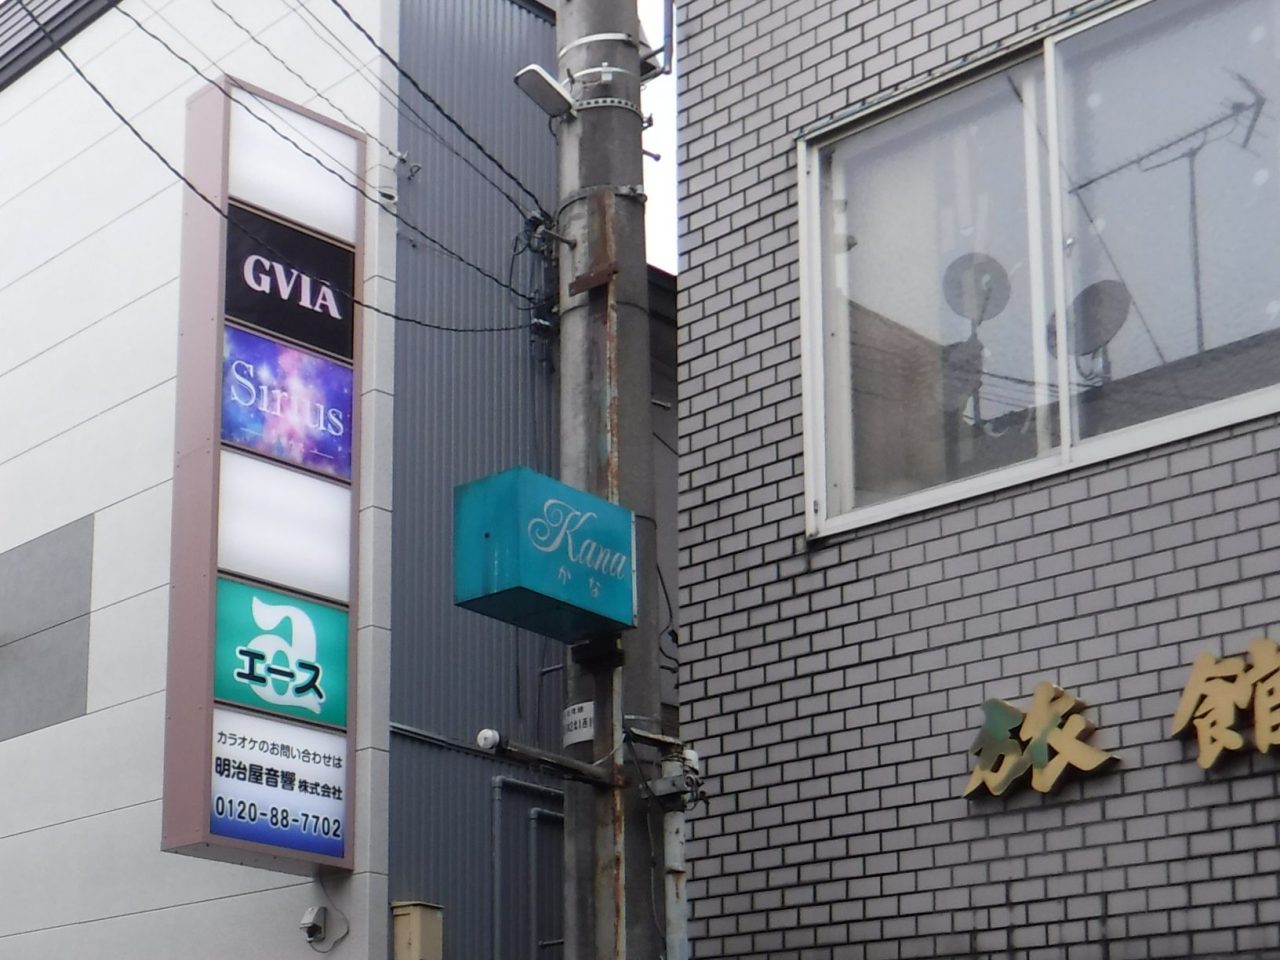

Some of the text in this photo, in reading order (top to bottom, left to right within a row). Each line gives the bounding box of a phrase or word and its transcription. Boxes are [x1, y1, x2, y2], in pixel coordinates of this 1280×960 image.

[242, 254, 342, 320] GVIA
[527, 498, 628, 580] Kana
[234, 646, 326, 702] エース
[217, 730, 343, 769] カラオケのお問い合わせは
[215, 796, 342, 838] 0120-88-7702
